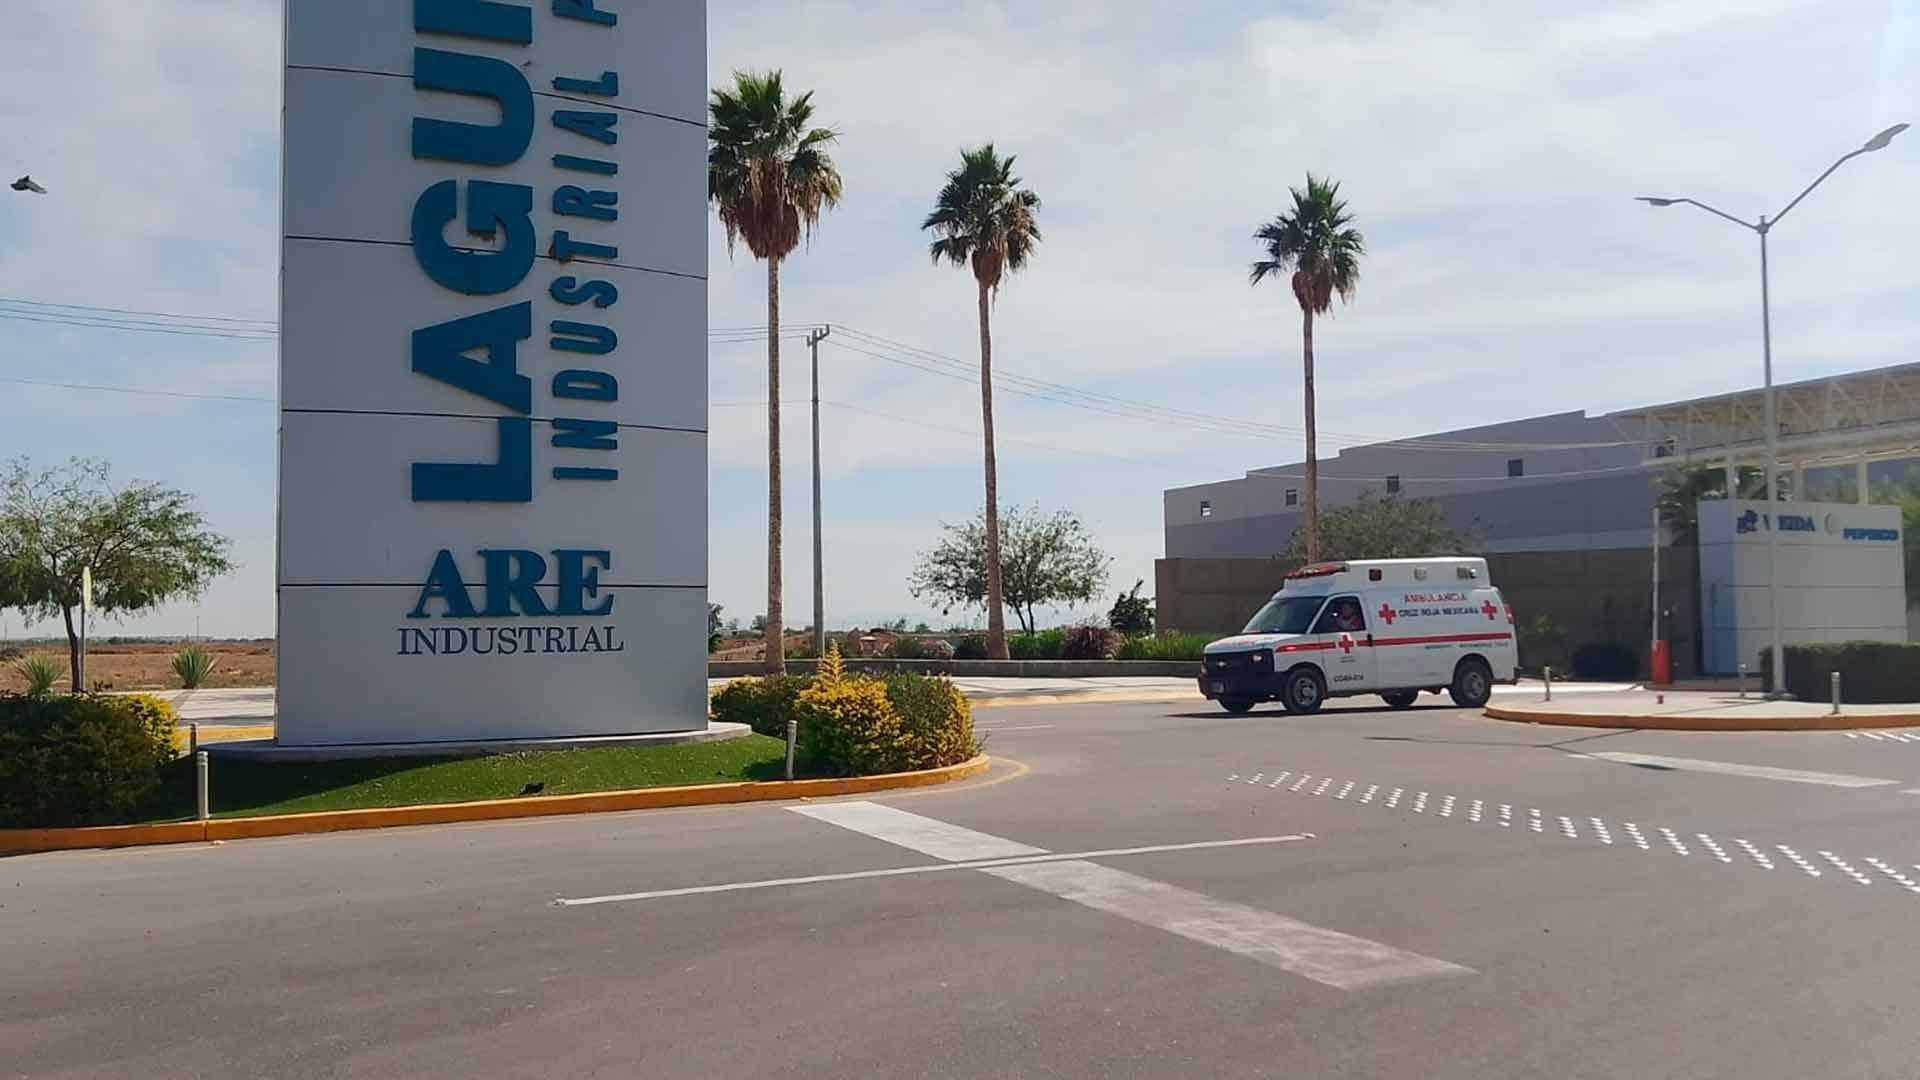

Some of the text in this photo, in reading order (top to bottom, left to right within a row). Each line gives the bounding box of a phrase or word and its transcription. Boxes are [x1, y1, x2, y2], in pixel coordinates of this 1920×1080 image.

[551, 71, 619, 481] INDUSTRIAL
[406, 548, 614, 618] ARE
[1404, 592, 1467, 603] AMBULANCIA
[1398, 605, 1479, 617] CRUZ ROJA MEXICANA
[396, 626, 624, 655] INDUSTRIAL
